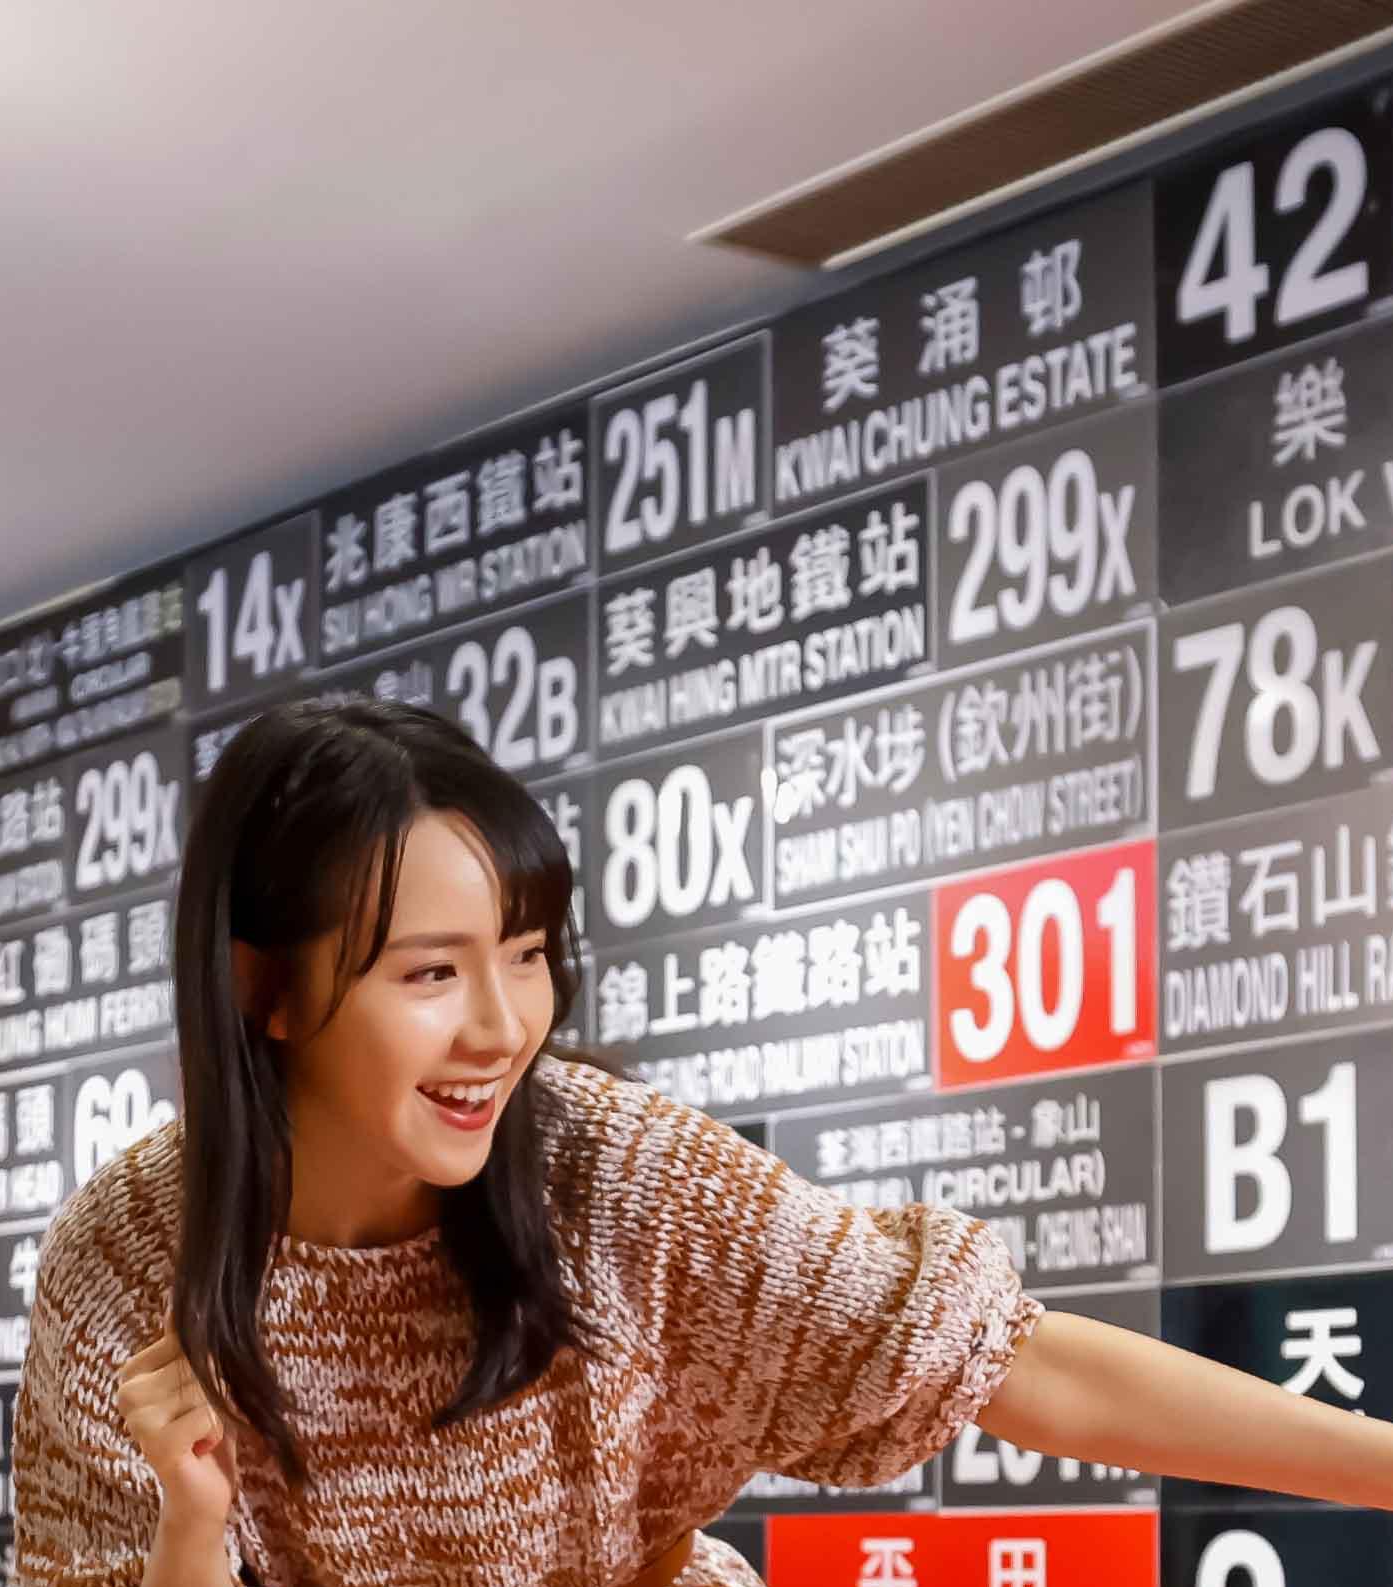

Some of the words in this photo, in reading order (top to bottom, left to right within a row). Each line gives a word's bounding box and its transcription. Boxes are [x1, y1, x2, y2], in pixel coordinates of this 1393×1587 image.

[1175, 126, 1370, 345] 42
[775, 419, 862, 503] KWAI
[861, 374, 992, 475] CHUNG
[995, 321, 1138, 432] ESTATE
[820, 237, 1084, 412] 葵涌邨
[605, 377, 758, 556] 251M
[948, 448, 1138, 643] 299X
[1249, 469, 1368, 559] LOK
[198, 550, 306, 693] 14X
[604, 500, 922, 678] 葵興地鐵站
[804, 605, 925, 691] STATION
[447, 626, 578, 770] 32B
[1174, 605, 1381, 800] 78K
[74, 751, 181, 891] 299X
[603, 764, 756, 928] 80X
[949, 866, 1138, 1063] 301
[1165, 951, 1289, 1038] DIAMOND
[1295, 941, 1360, 1015] HILL
[1203, 1060, 1361, 1256] B1
